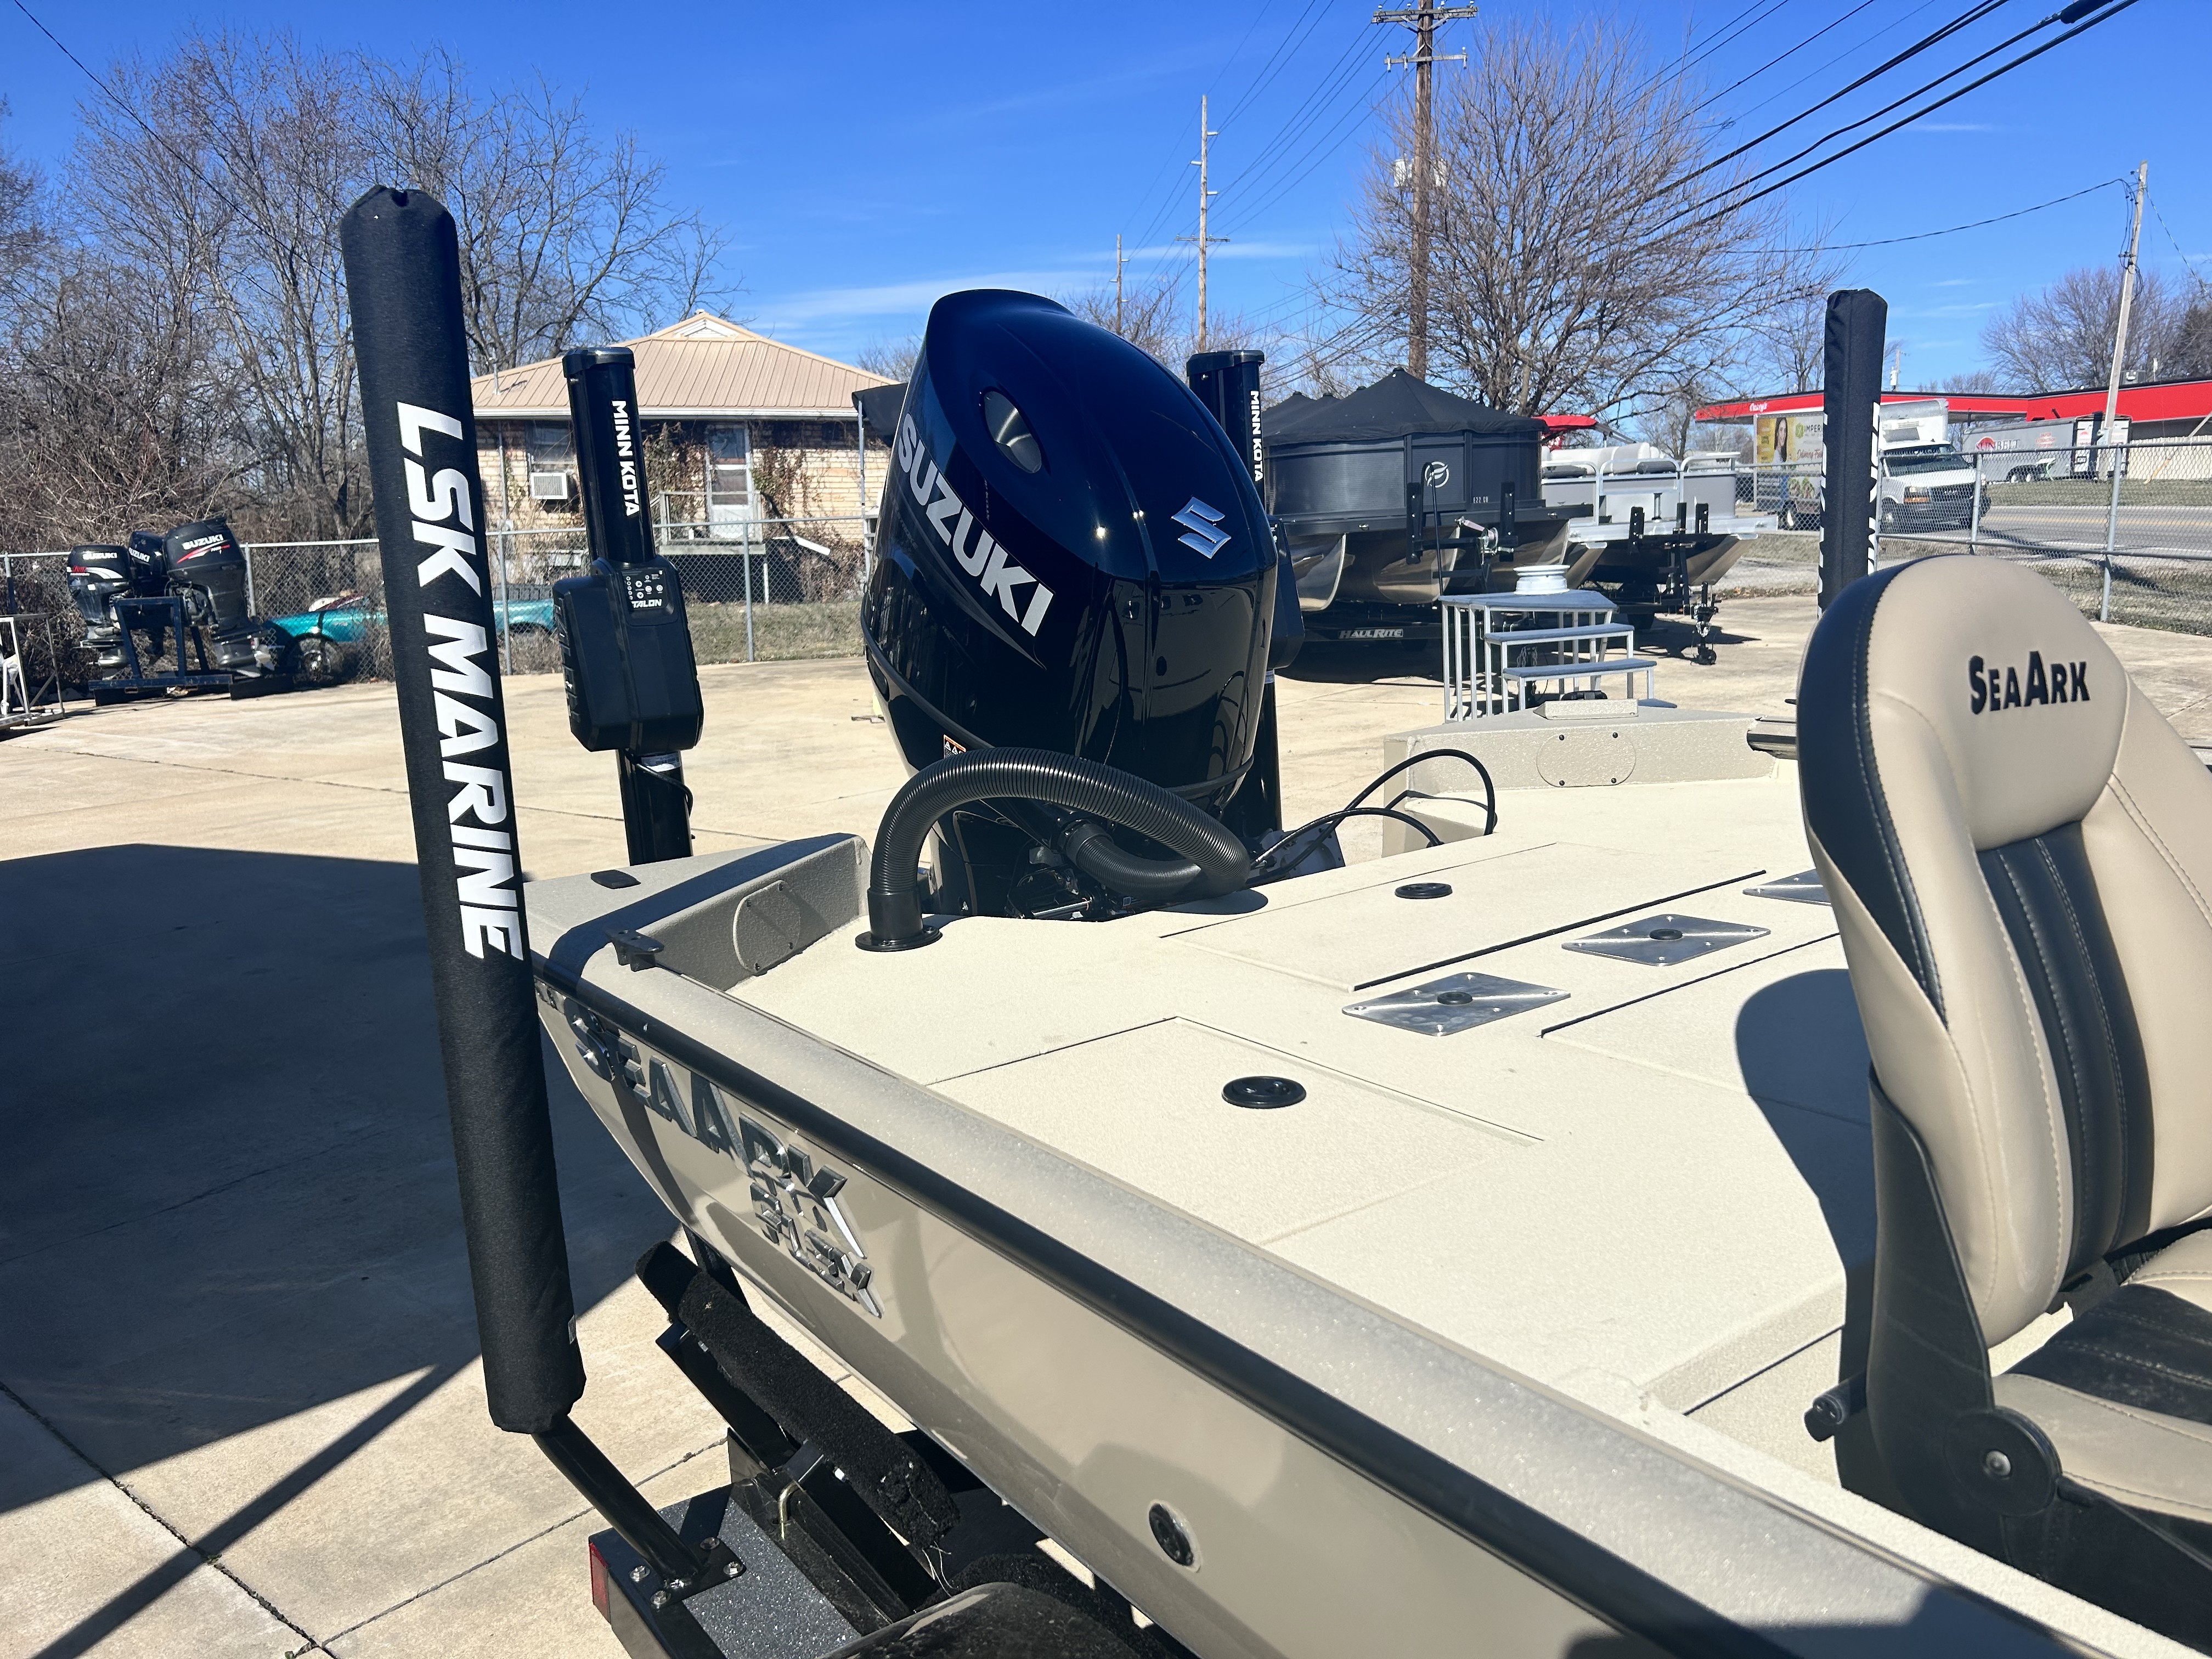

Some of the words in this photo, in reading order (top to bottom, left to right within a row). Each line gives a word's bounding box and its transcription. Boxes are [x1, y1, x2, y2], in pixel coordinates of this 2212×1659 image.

[611, 400, 633, 456] MINN
[1250, 391, 1261, 435] MINN
[1253, 438, 1263, 482] KOTA
[397, 401, 482, 597] LSK
[619, 461, 640, 516] KOTA
[182, 534, 224, 550] SUZUKI
[898, 413, 1054, 637] SUZUKI
[83, 551, 117, 560] SUZUKI
[631, 599, 662, 608] TALON
[423, 612, 525, 961] MARINE
